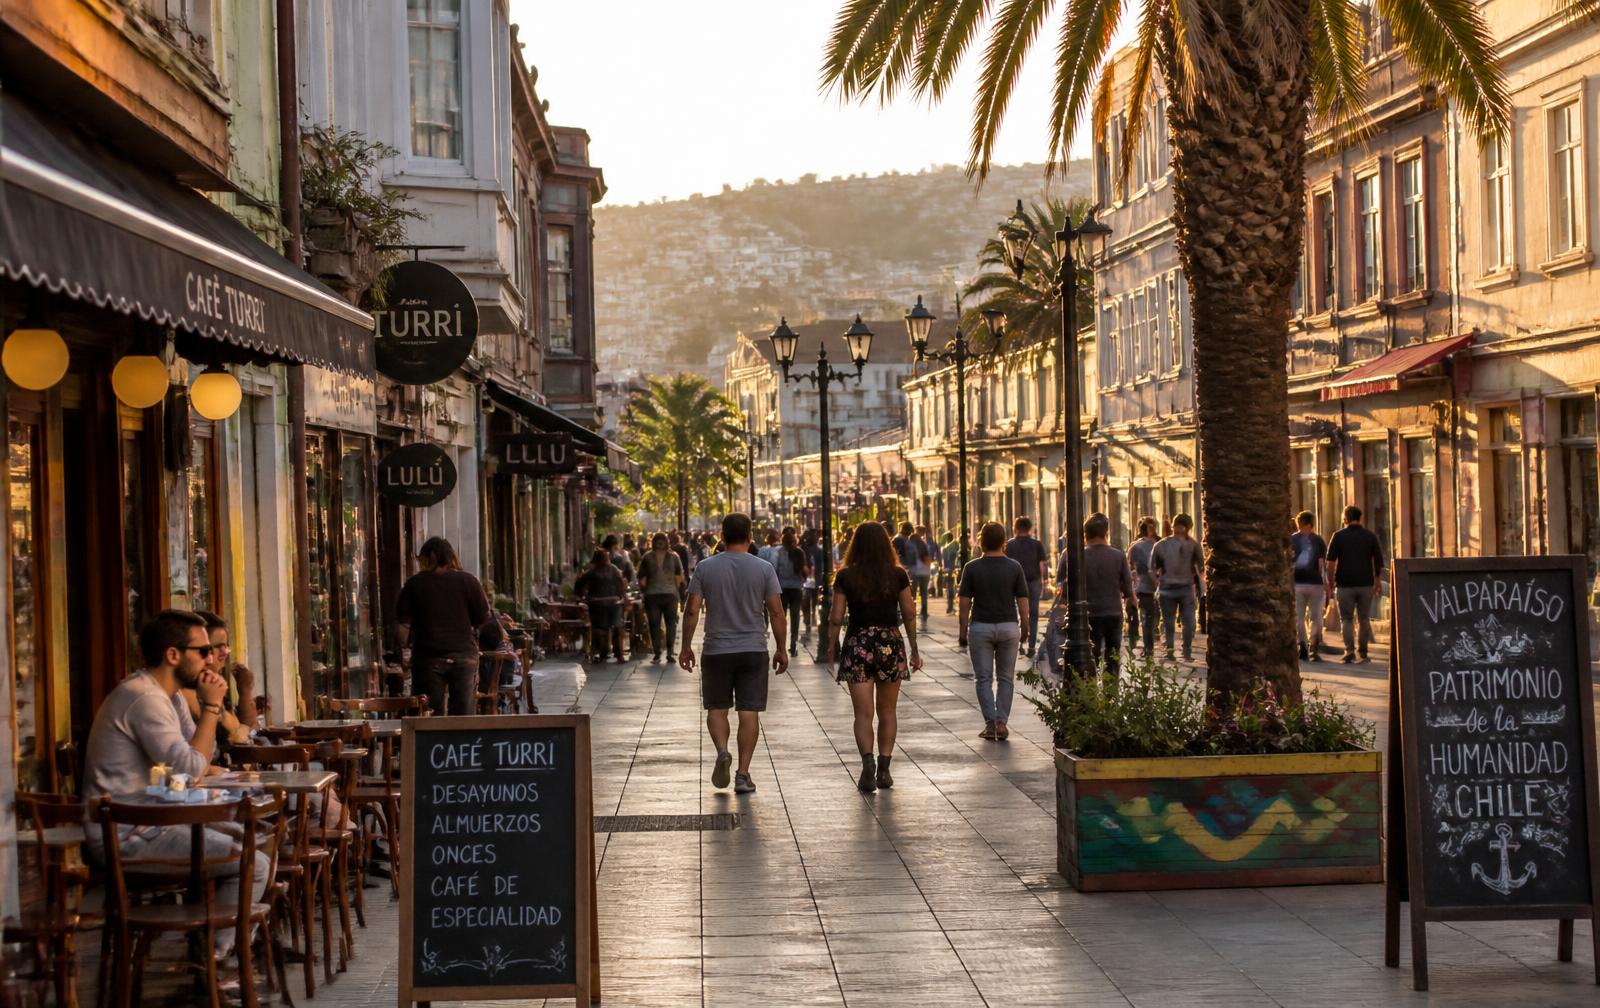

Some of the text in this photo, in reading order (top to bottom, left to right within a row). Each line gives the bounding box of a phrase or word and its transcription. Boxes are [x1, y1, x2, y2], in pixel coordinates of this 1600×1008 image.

[1419, 578, 1564, 623] VALPARAÍSO
[1429, 666, 1562, 704] PATRIMONIO
[1466, 704, 1519, 733] de la
[430, 737, 483, 769] CAFÉ
[1430, 741, 1568, 775] HUMANIDAD
[432, 783, 539, 804] DESAYUNOS
[1455, 783, 1544, 818] CHILE
[432, 813, 541, 834] ALMUERZOS
[432, 844, 497, 865] ONCES
[431, 870, 520, 896] CAFÉ DE
[432, 905, 562, 928] ESPECIALIDAD
